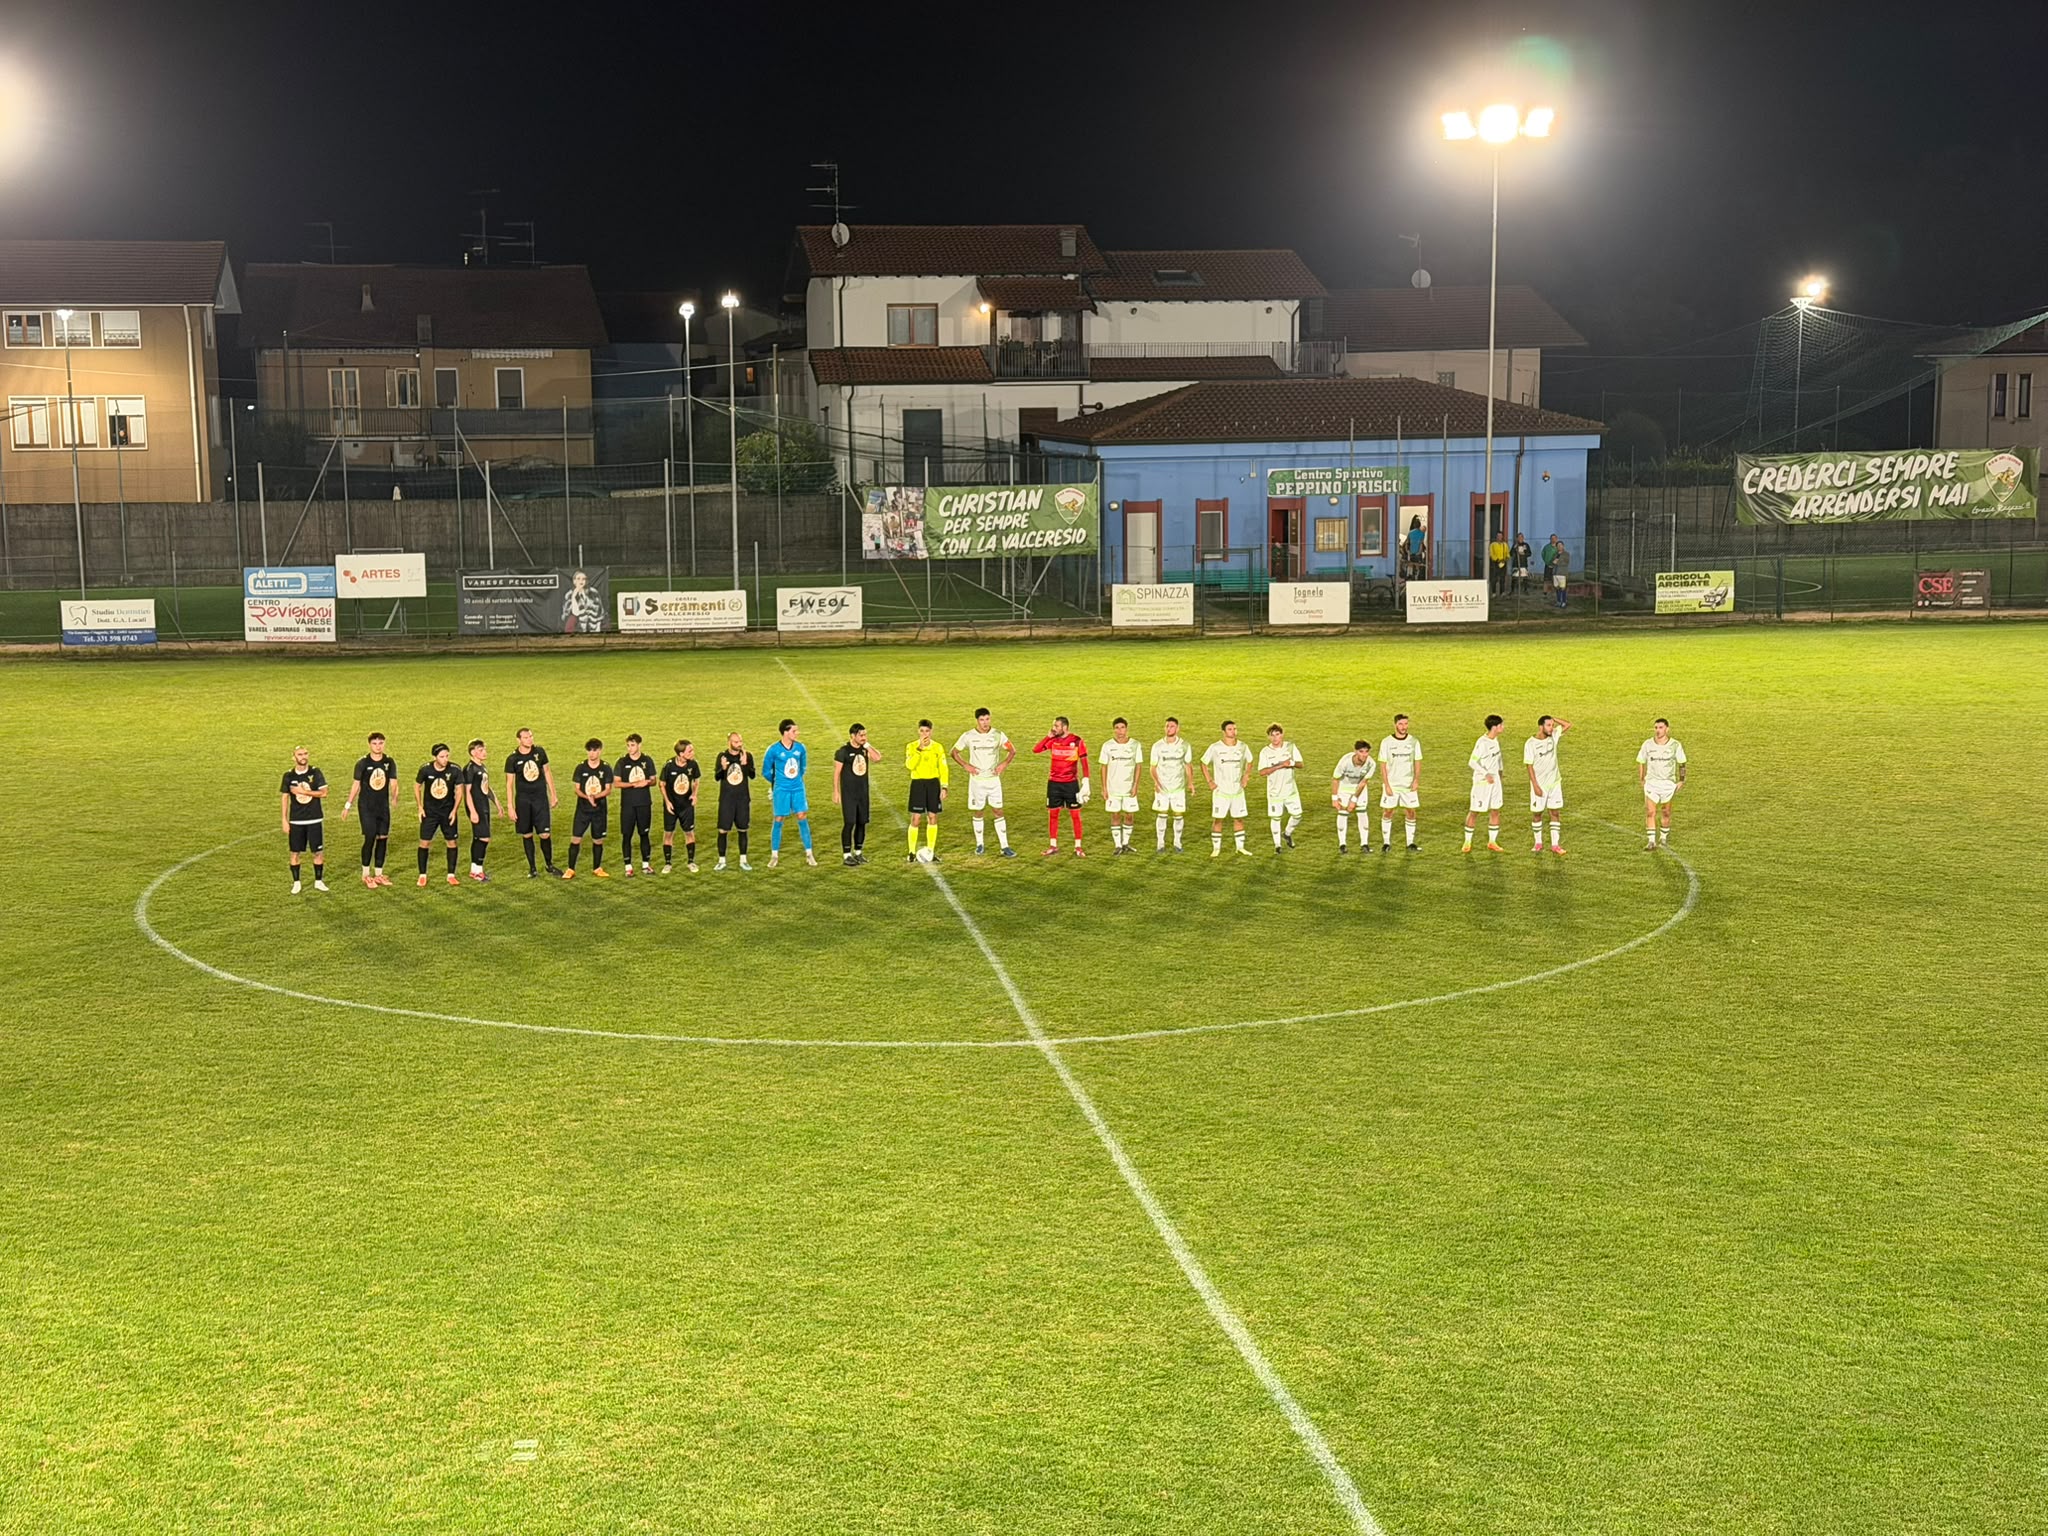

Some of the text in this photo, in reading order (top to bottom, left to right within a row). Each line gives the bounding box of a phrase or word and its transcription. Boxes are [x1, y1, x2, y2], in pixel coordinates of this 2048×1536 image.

[1294, 469, 1332, 480] Centro
[1743, 451, 1961, 495] CREDERCI SEMPRE
[1275, 481, 1342, 495] PEPPINO
[938, 489, 1044, 518] CHRISTIAN
[1789, 482, 1970, 518] ARRENDERSI MAI
[943, 512, 1030, 536] PER SEMPRE
[939, 527, 1087, 555] CON LA VALCERESIO
[361, 569, 401, 579] ARTES
[1657, 573, 1711, 581] AGRICOLA
[255, 579, 289, 588] ALETTI
[467, 578, 554, 587] VARESE PELLICCE
[1918, 577, 1954, 594] CSE
[1136, 586, 1190, 600] SPINAZZA
[91, 608, 115, 616] Studio
[645, 597, 726, 616] Serramenti
[295, 618, 332, 626] VARESE
[83, 635, 96, 643] Tel.
[121, 634, 138, 642] 0743
